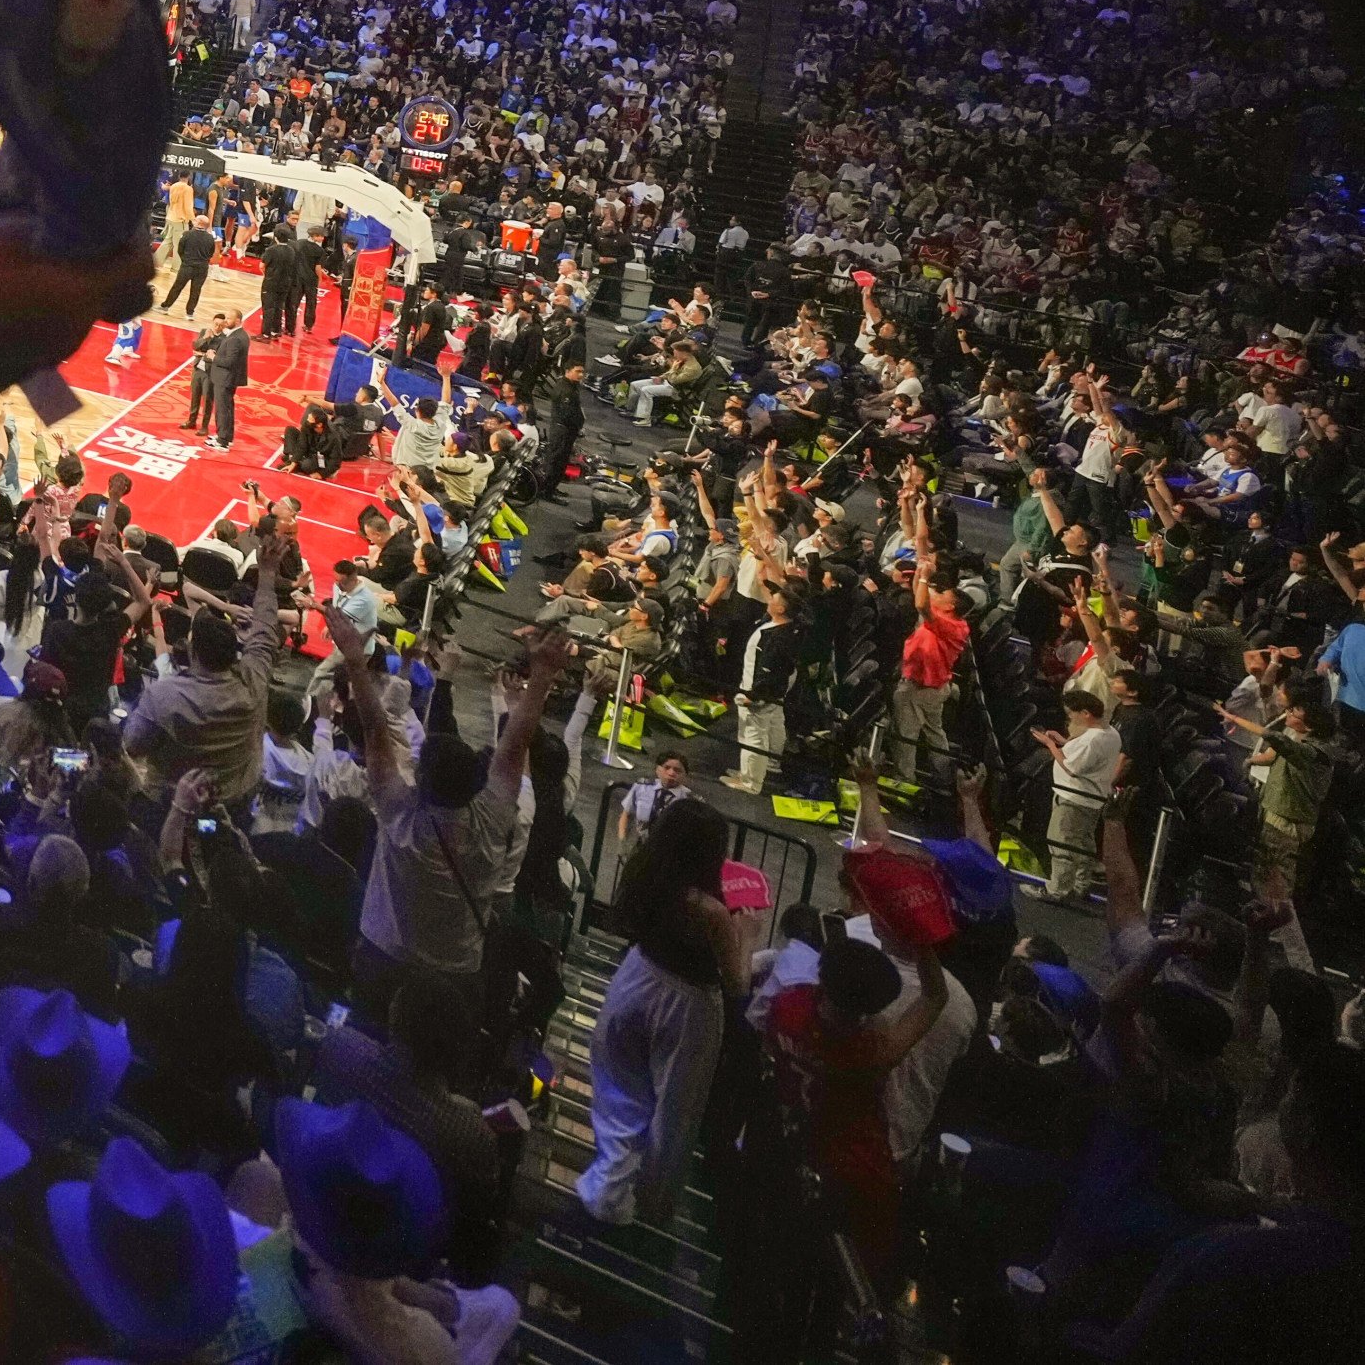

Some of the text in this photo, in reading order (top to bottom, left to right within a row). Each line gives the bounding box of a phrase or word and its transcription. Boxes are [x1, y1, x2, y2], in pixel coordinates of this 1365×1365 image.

[418, 110, 449, 127] 2:46
[414, 123, 442, 142] 24
[415, 149, 448, 160] TISSOT
[412, 157, 443, 172] 0:24
